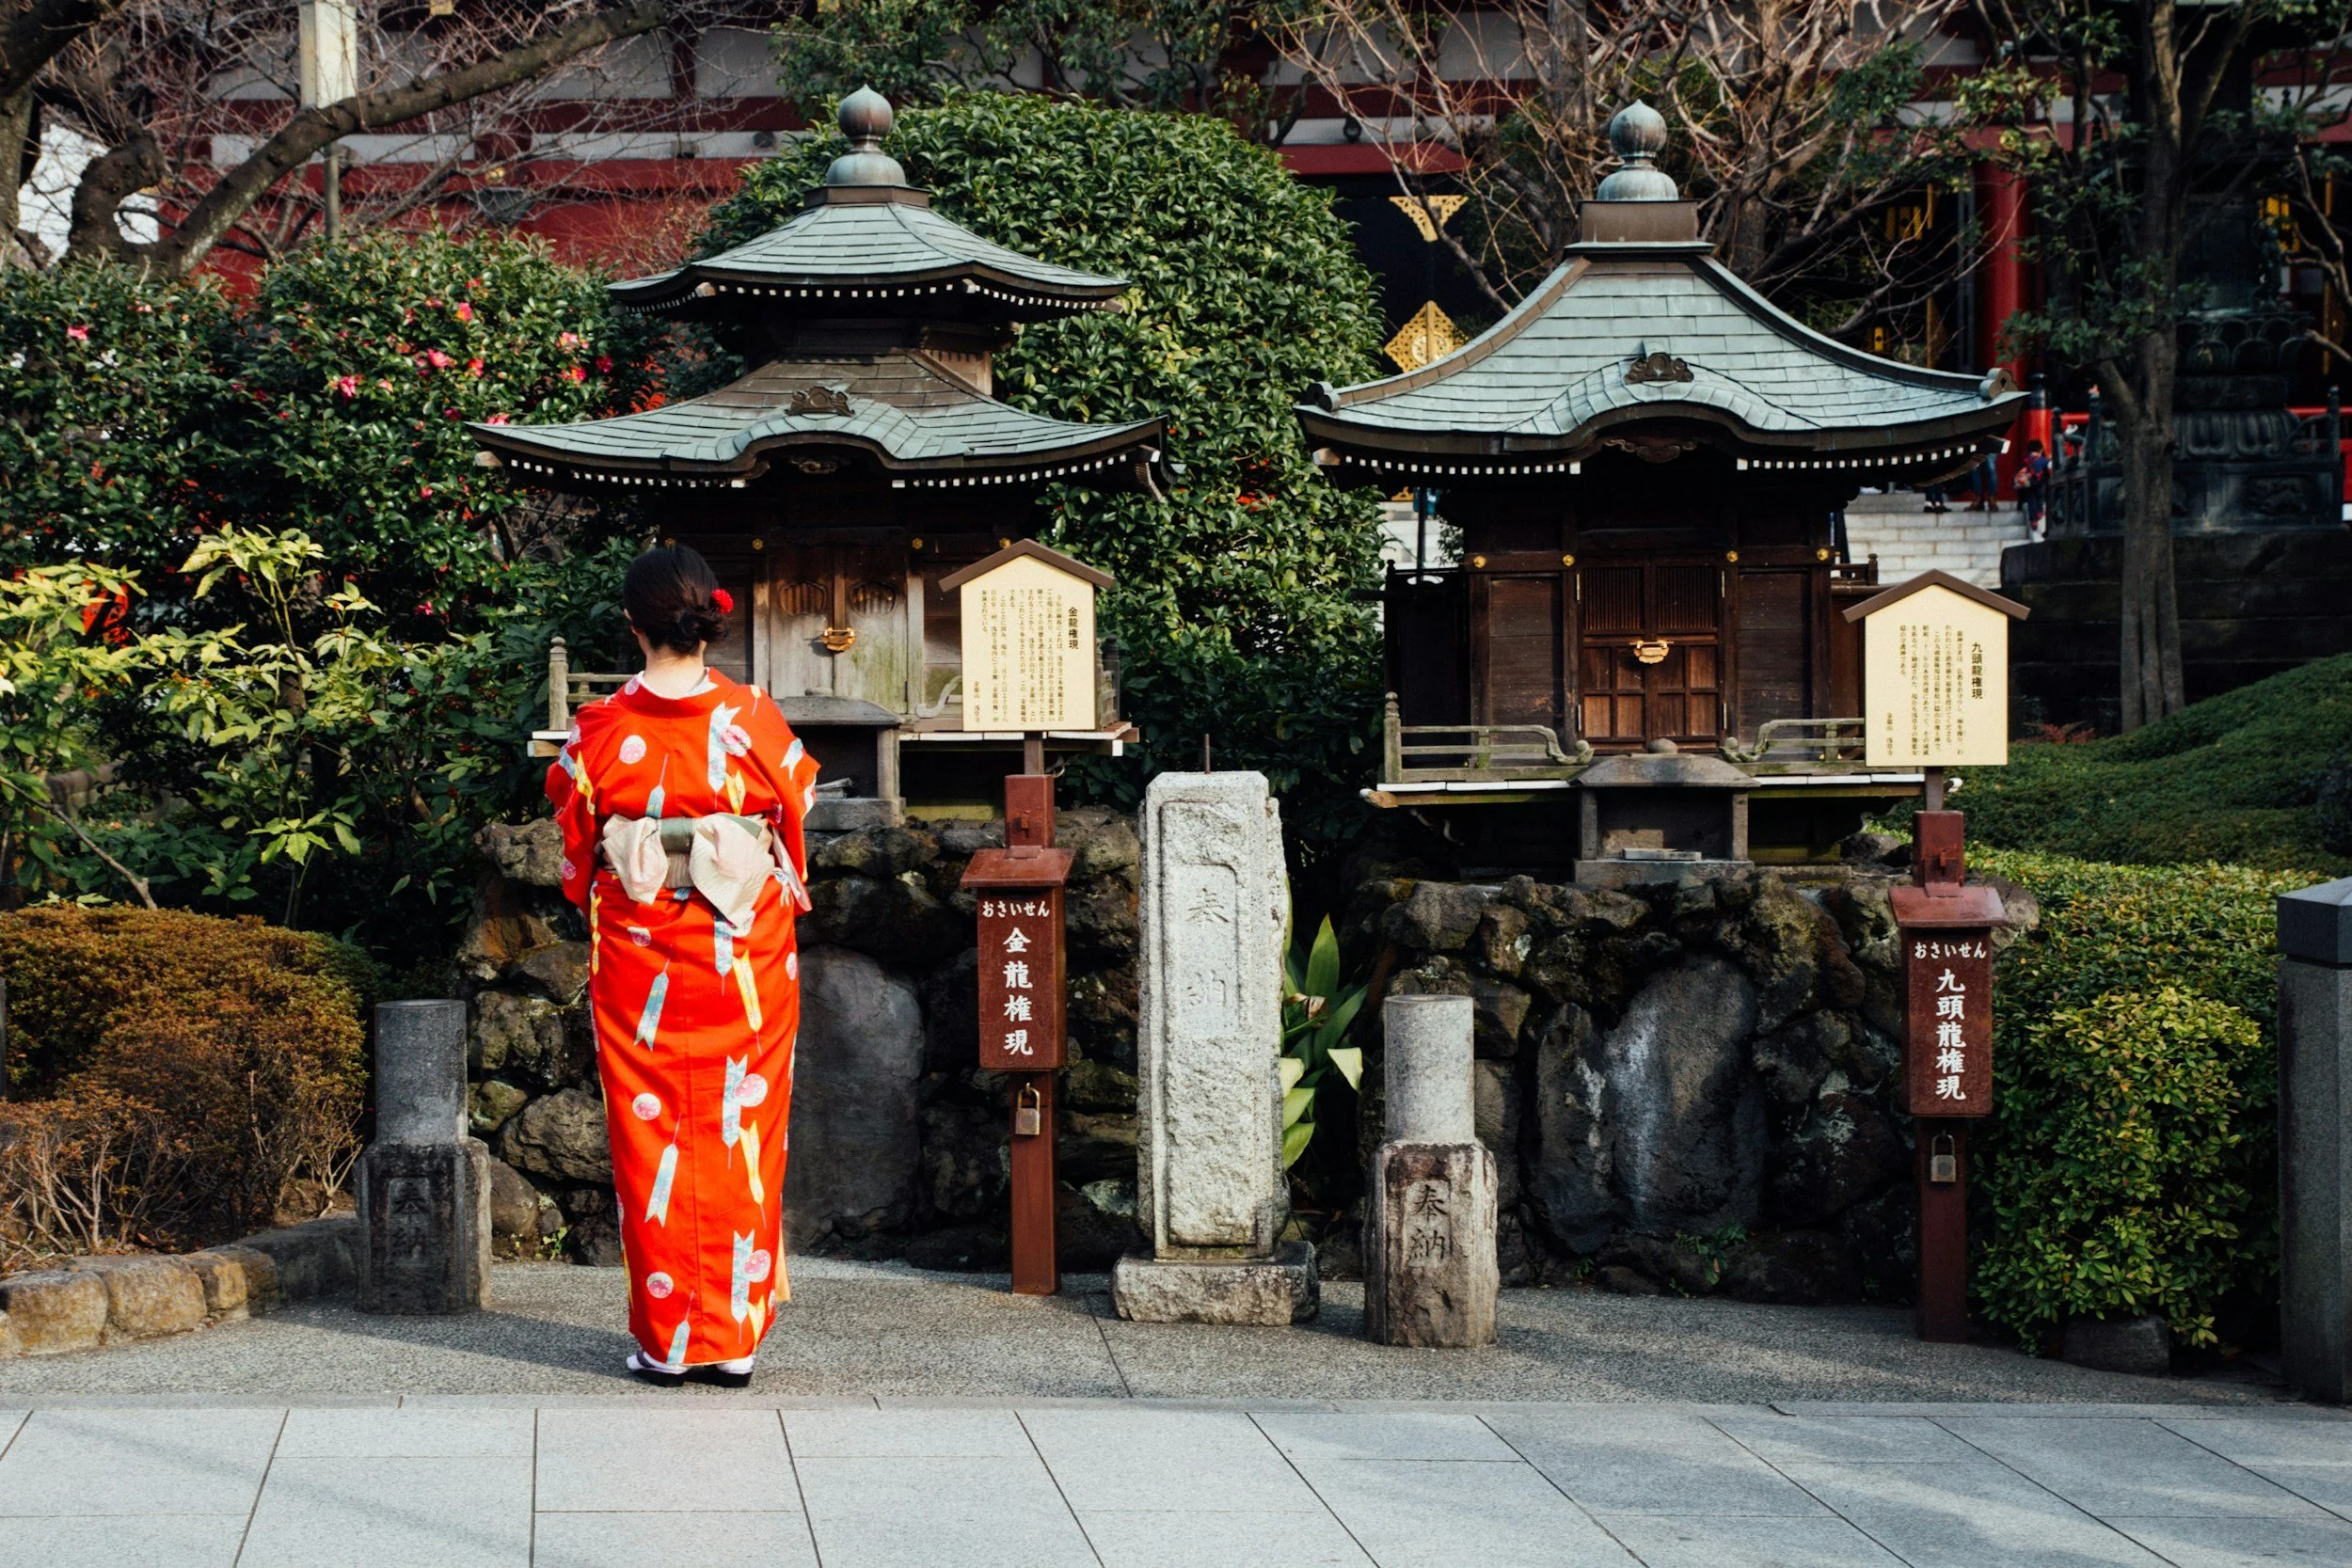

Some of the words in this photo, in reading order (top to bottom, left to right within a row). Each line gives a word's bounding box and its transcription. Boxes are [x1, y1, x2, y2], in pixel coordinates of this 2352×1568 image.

[1069, 607, 1078, 649] 金龍権現
[1972, 642, 1983, 699] 九頭龍権現
[982, 900, 1050, 917] おさいせん
[1185, 885, 1230, 1008] 奉納
[1915, 942, 1987, 958] おさいせん
[1003, 927, 1033, 1055] 金龍権現
[1935, 968, 1966, 1101] 九頭龍権現
[391, 1182, 429, 1258] 奉納
[1407, 1184, 1449, 1261] 奉納
